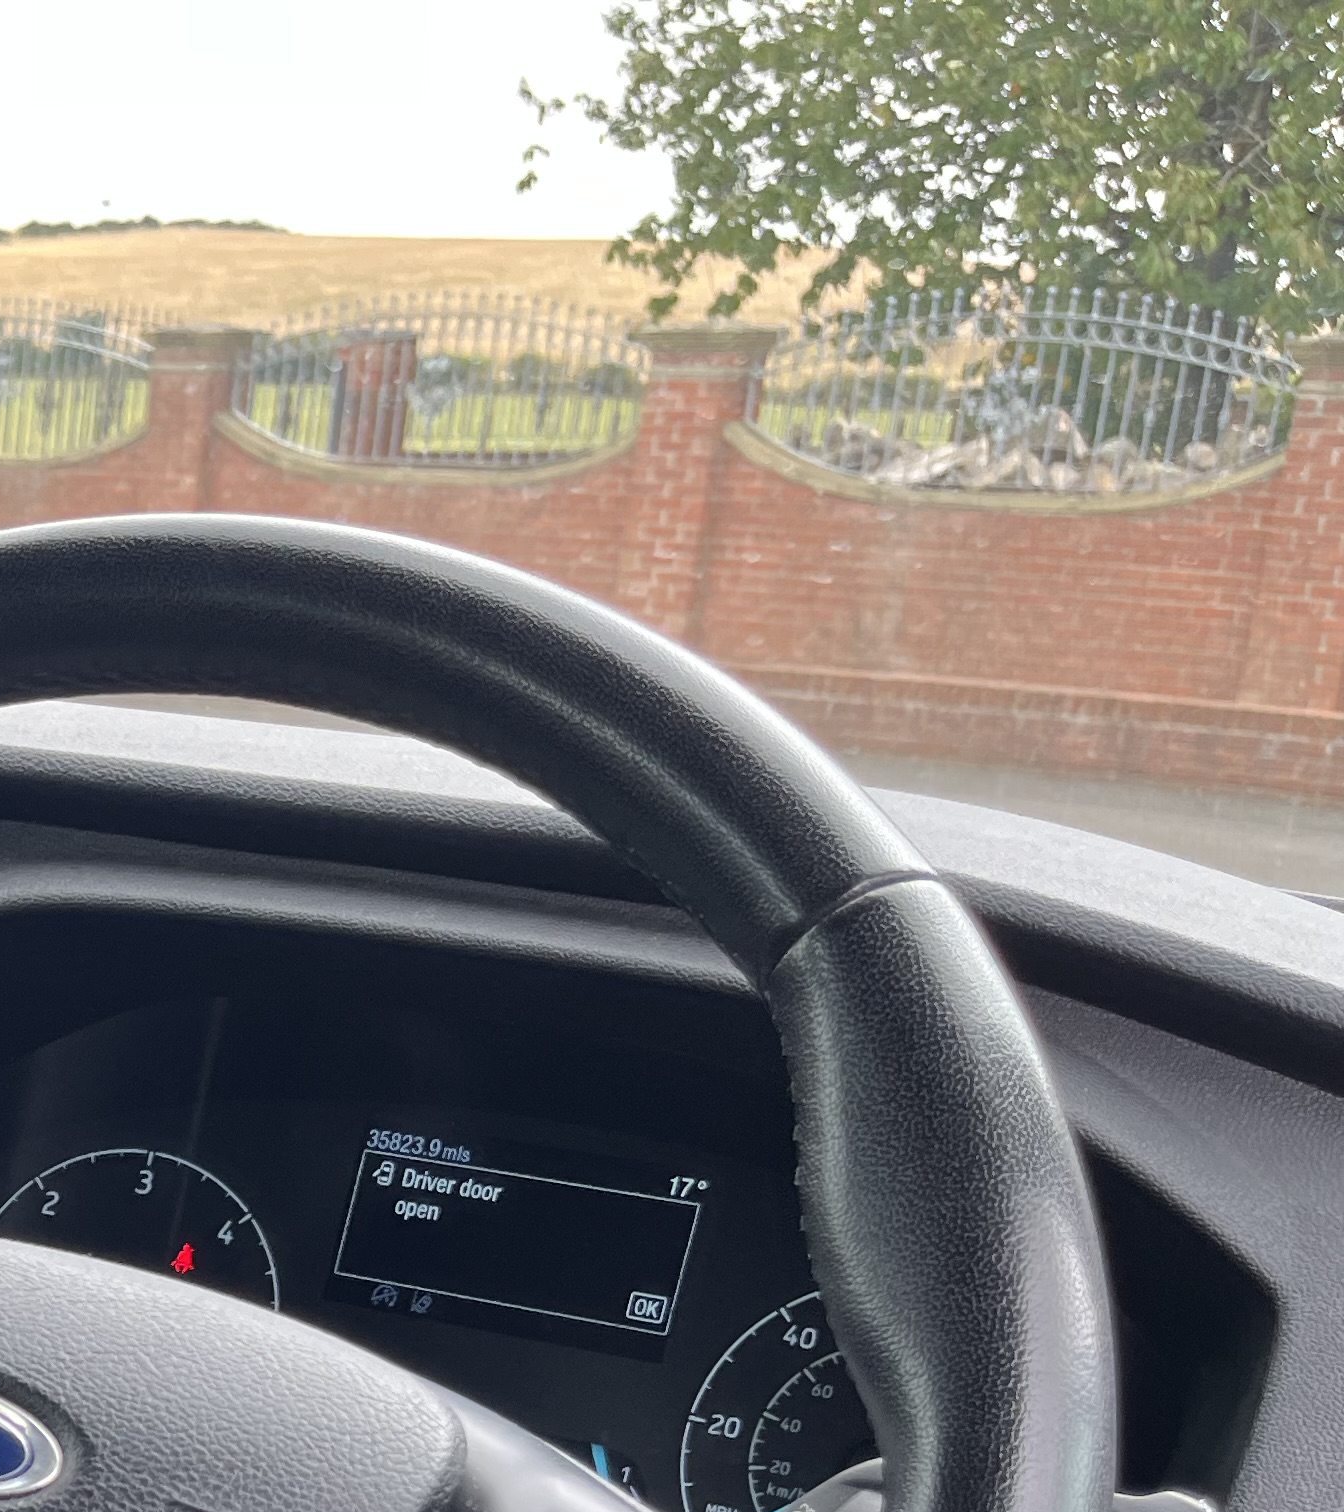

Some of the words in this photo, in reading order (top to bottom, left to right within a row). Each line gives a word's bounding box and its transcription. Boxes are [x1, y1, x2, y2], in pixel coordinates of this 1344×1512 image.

[367, 1129, 442, 1157] 35823.9
[134, 1169, 154, 1195] 3
[401, 1167, 458, 1195] Driver
[459, 1177, 503, 1203] door
[40, 1190, 60, 1216] 2
[394, 1200, 441, 1221] open
[216, 1220, 234, 1246] 4
[633, 1298, 661, 1319] OK
[782, 1324, 818, 1350] 40
[811, 1383, 834, 1399] 60
[707, 1414, 742, 1439] 20
[780, 1416, 802, 1433] 40
[769, 1459, 792, 1476] 20
